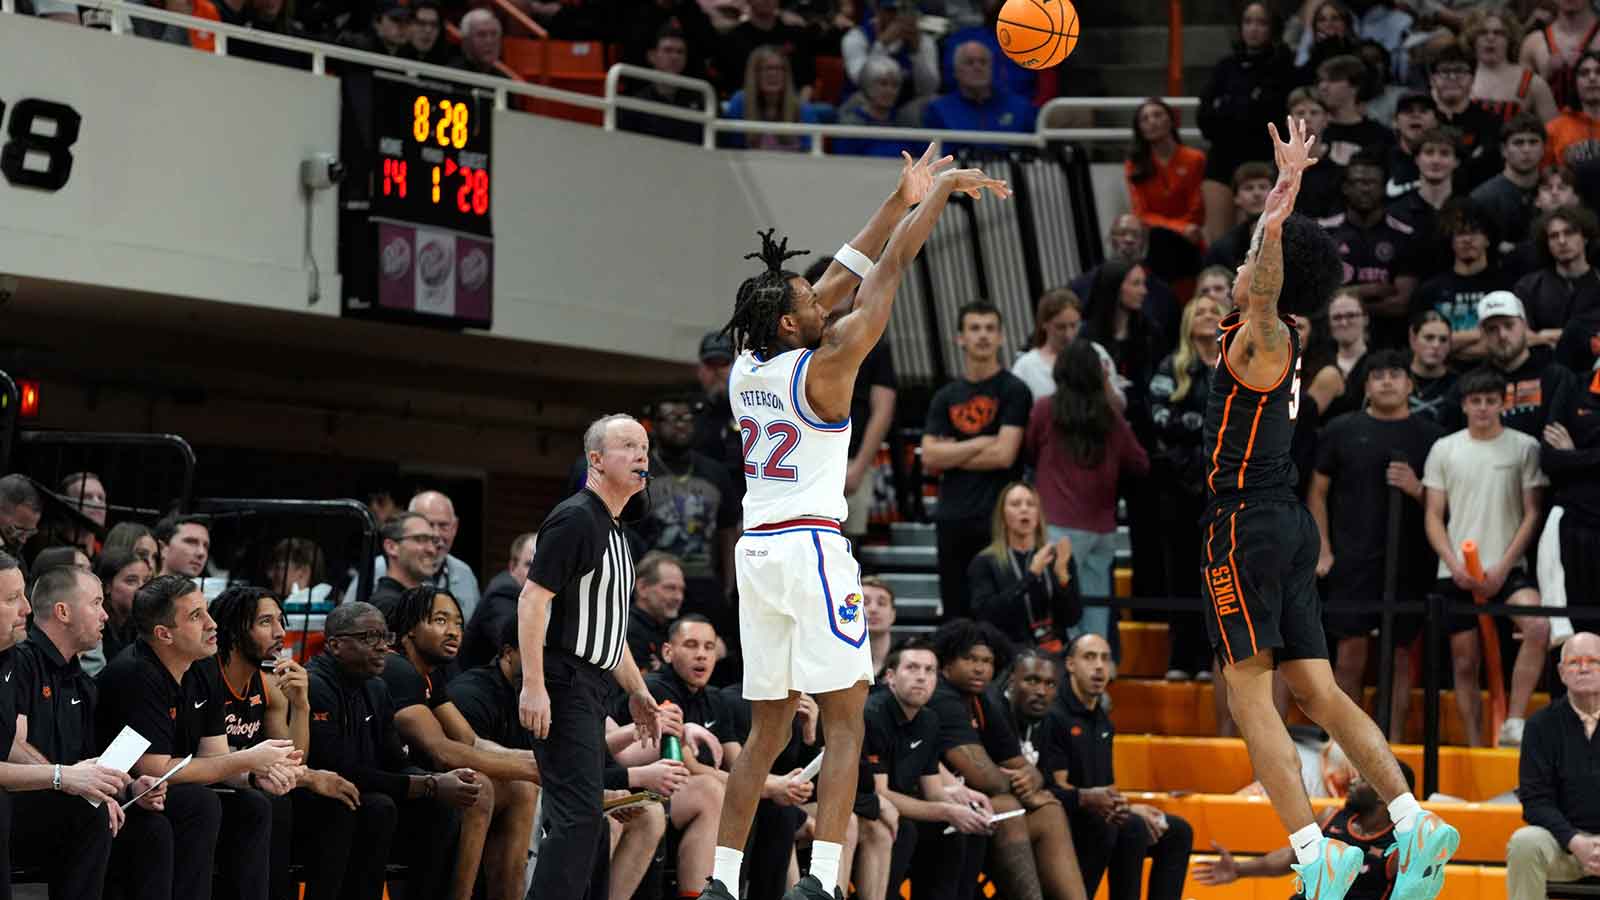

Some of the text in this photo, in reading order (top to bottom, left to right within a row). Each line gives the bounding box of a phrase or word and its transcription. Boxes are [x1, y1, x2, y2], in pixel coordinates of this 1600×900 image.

[0, 97, 82, 193] 8
[383, 158, 489, 215] 14 1 28
[740, 390, 785, 412] PETERSON
[739, 415, 802, 483] 22
[1211, 565, 1241, 617] POKES
[225, 713, 261, 739] Cowboys
